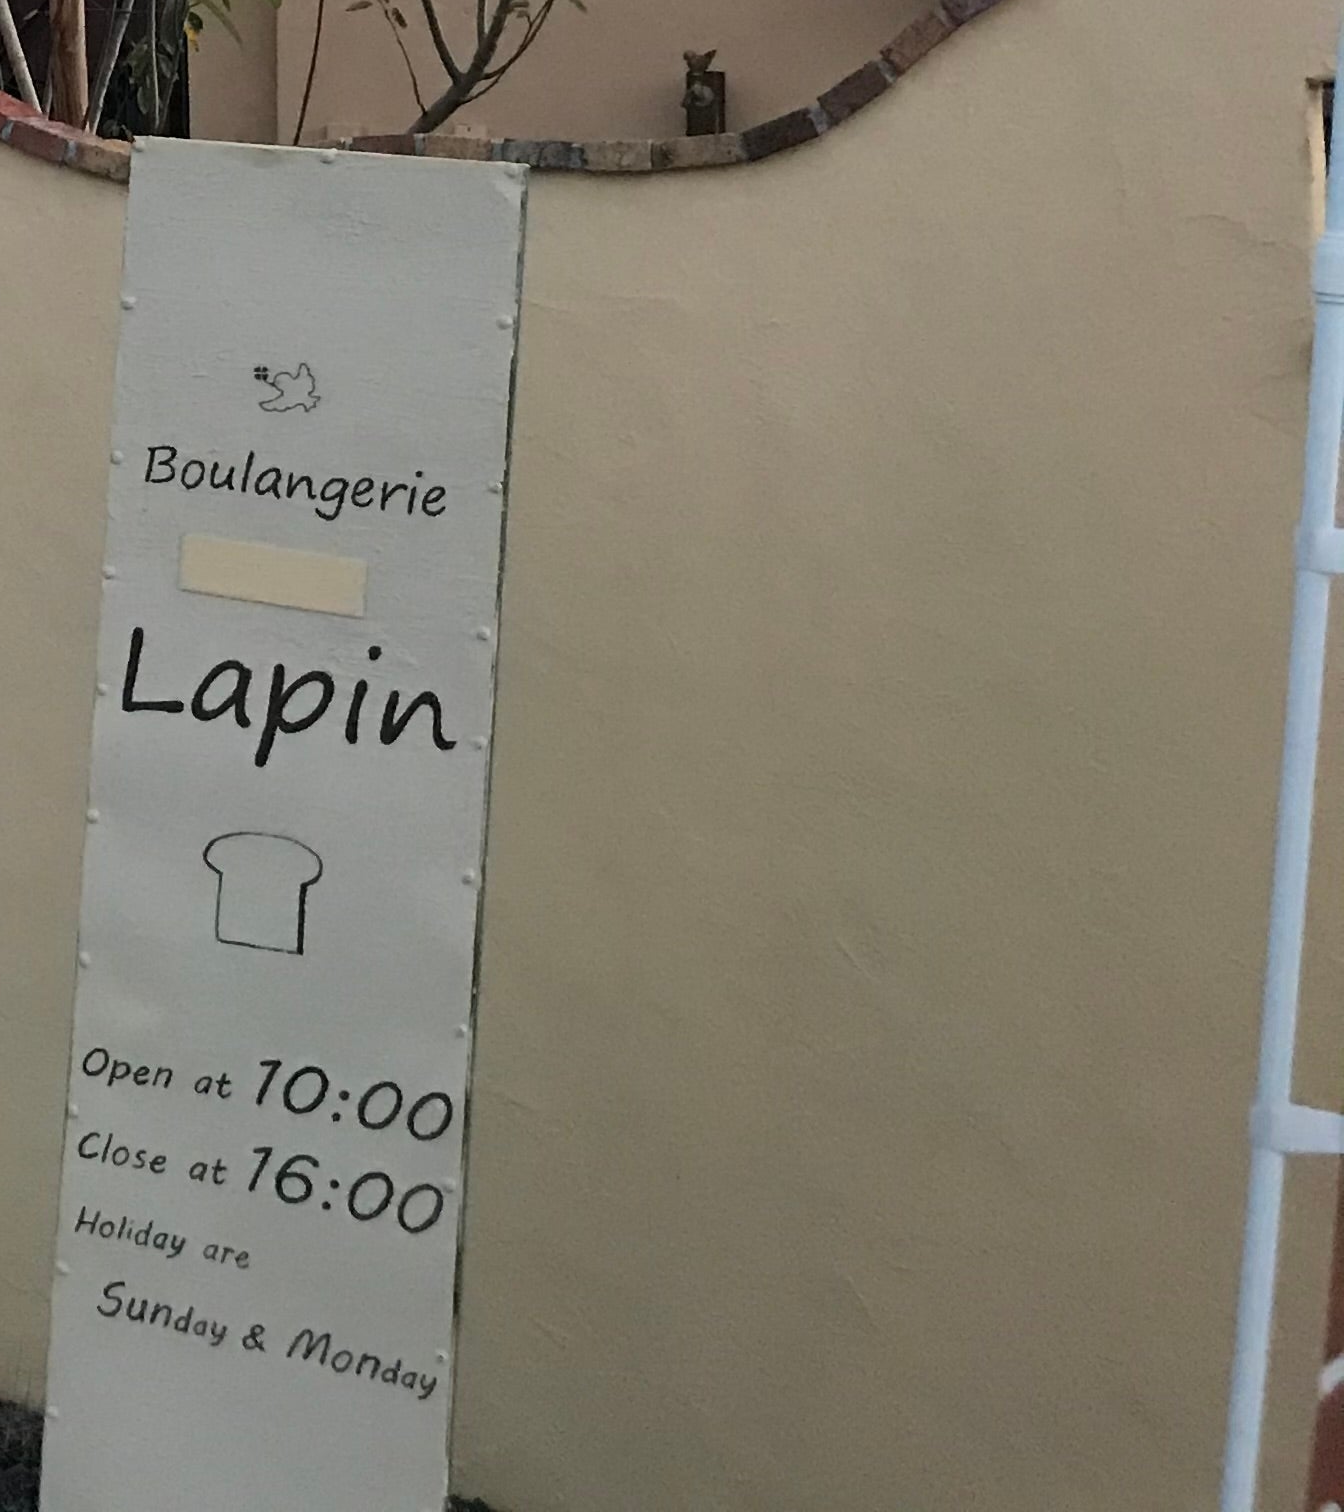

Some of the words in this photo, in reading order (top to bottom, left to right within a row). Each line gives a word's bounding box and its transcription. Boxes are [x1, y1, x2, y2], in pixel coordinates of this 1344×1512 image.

[144, 445, 447, 521] Boulangerie
[122, 627, 457, 767] Lapin
[82, 1047, 173, 1088] Open
[193, 1072, 233, 1099] at
[255, 1059, 454, 1141] 10:00
[77, 1131, 167, 1174] Close
[188, 1157, 228, 1186] at
[248, 1146, 445, 1234] 16:00
[74, 1205, 187, 1259] Holiday
[202, 1242, 250, 1270] are
[96, 1281, 228, 1347] Sunday
[242, 1324, 267, 1354] &
[286, 1328, 438, 1401] Monday
